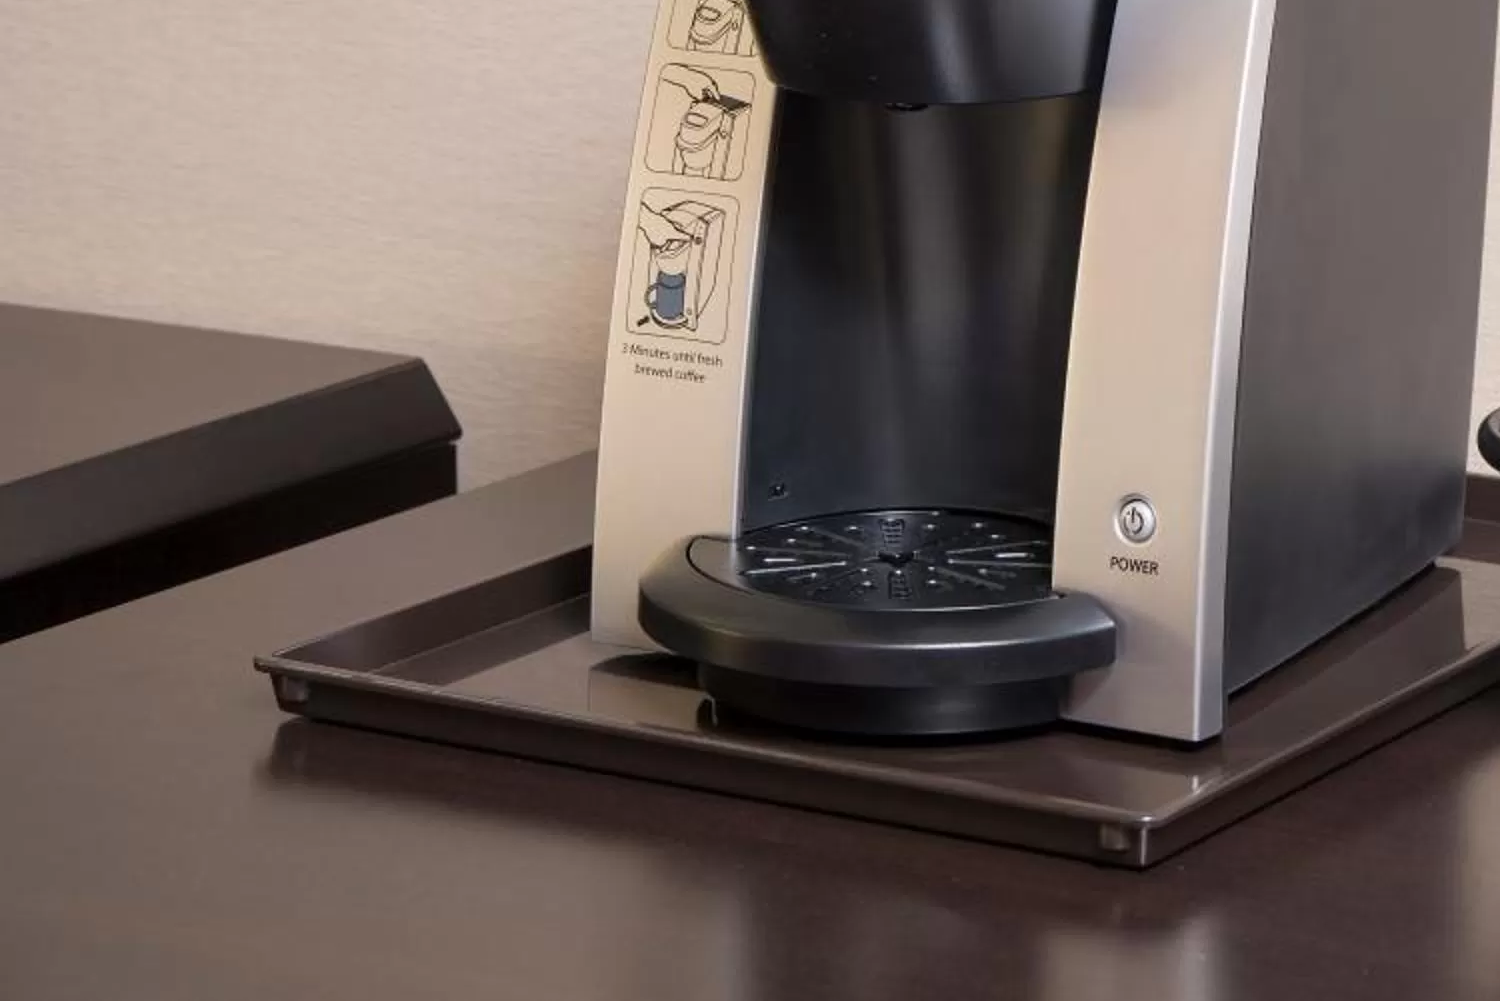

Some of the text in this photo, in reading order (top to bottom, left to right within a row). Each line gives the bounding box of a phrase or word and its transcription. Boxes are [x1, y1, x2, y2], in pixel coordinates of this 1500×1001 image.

[629, 343, 671, 361] Minutes
[697, 352, 724, 368] fresh
[634, 363, 706, 383] brewed coffee
[1109, 555, 1159, 576] POWER
